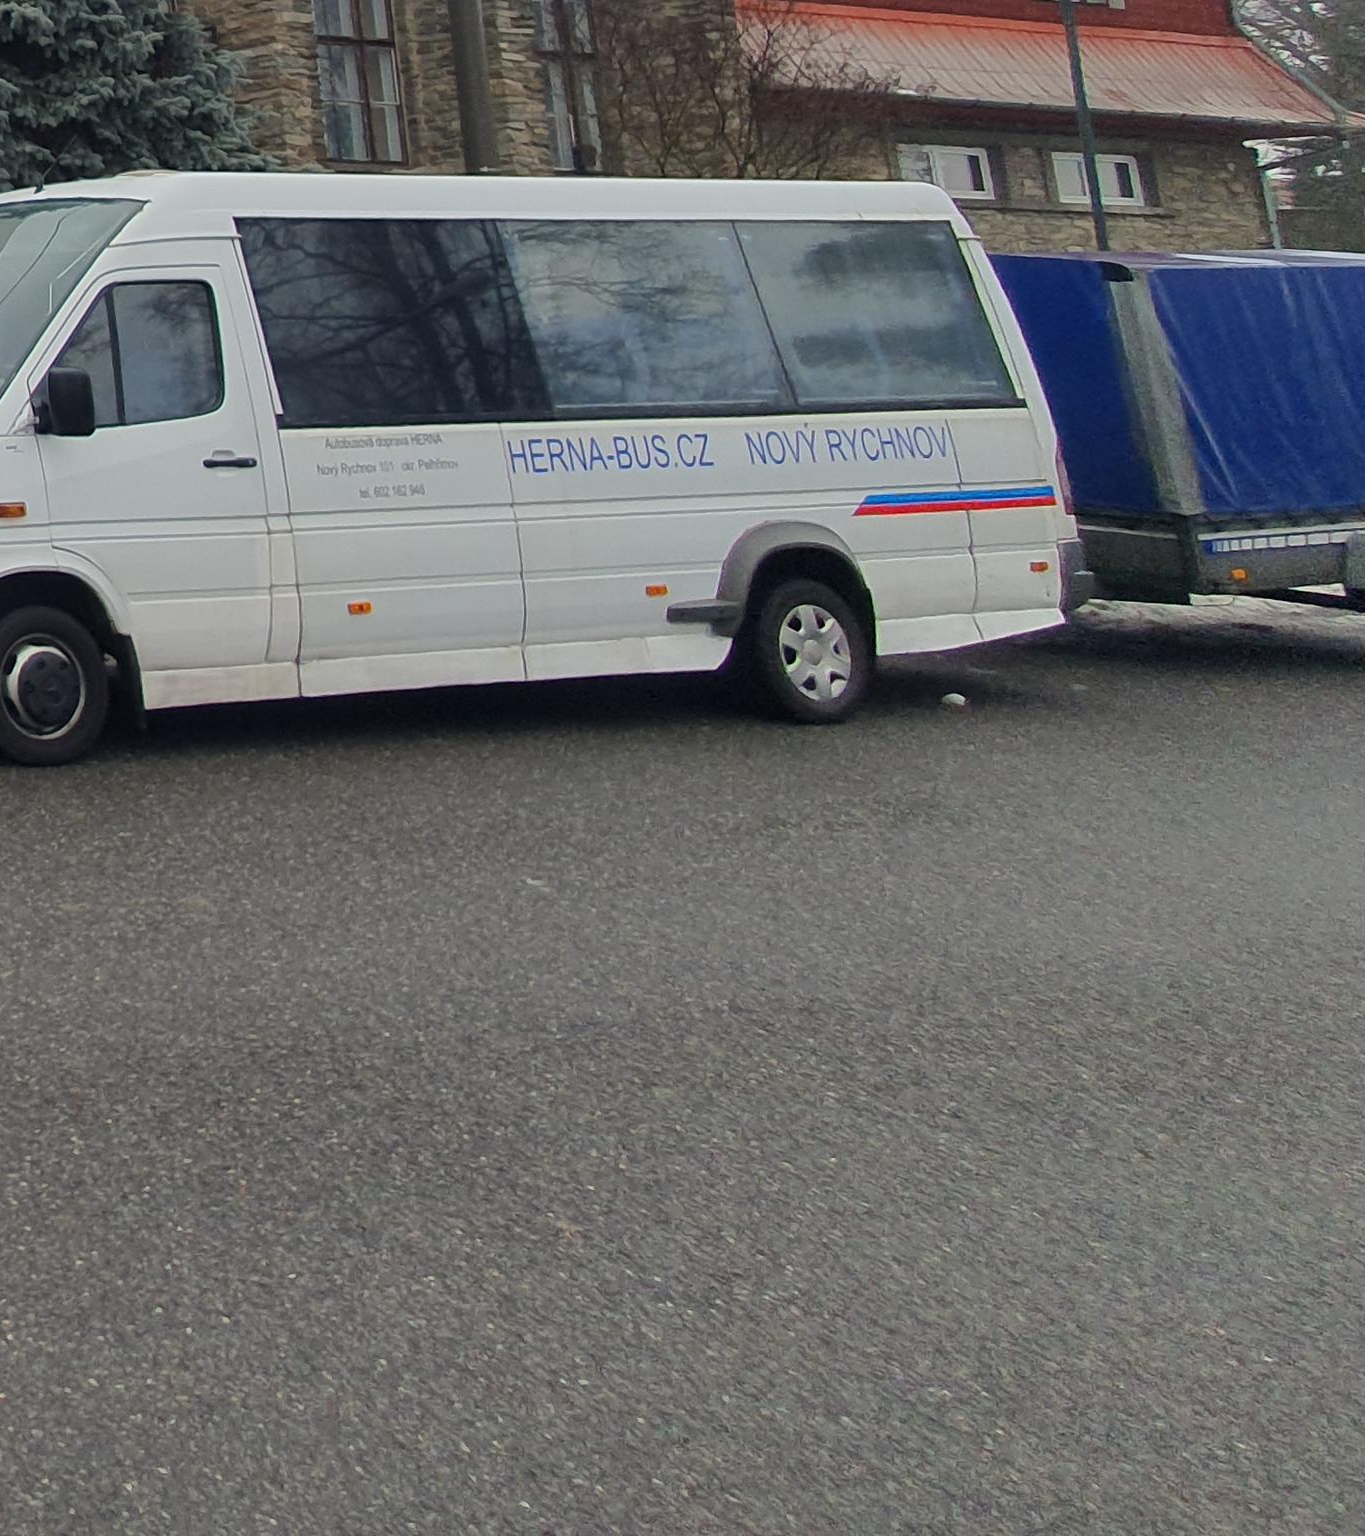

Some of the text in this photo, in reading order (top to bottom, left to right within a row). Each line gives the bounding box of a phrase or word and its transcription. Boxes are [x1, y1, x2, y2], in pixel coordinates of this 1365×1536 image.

[410, 433, 443, 446] HERNA
[507, 422, 947, 474] HERNA-BUS.CZ NOVÝ RYCHNOV
